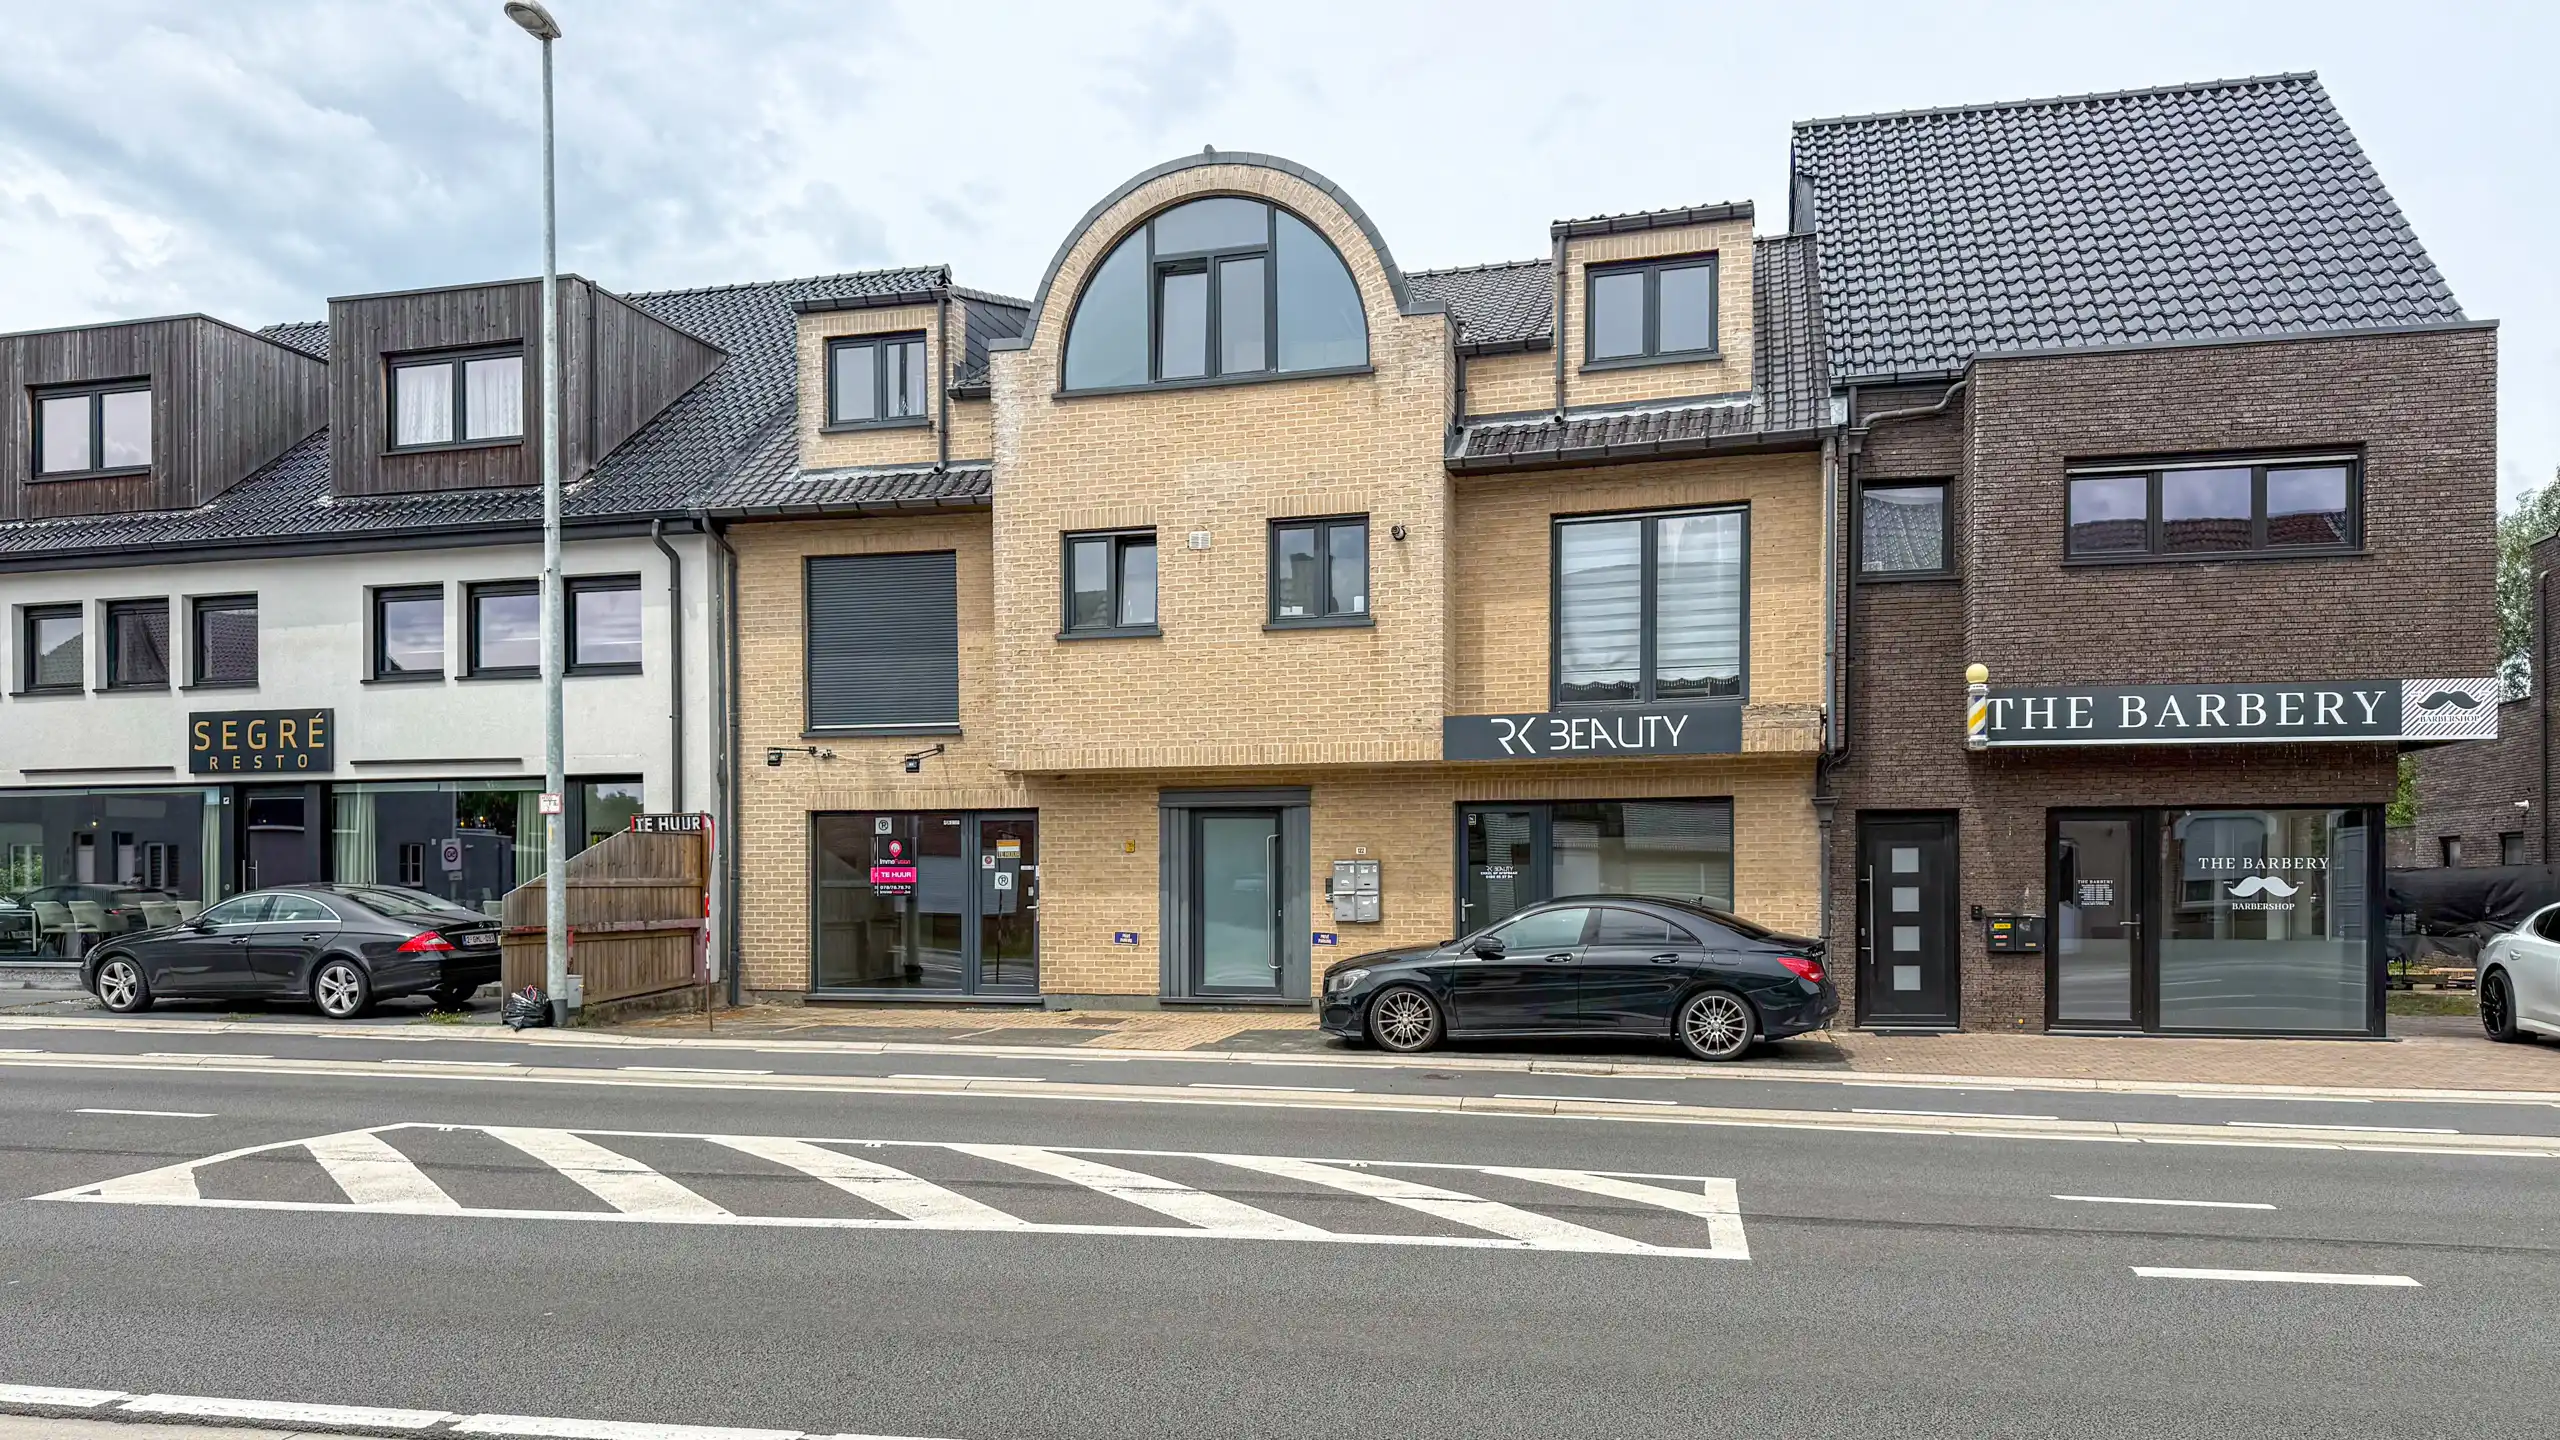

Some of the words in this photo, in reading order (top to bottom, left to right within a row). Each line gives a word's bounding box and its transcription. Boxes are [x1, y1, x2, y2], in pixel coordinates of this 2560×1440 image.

[1985, 696, 2094, 730] THE
[2118, 690, 2387, 728] BARBERY
[2420, 715, 2480, 723] BARBERSHOP
[193, 711, 325, 751] SEGRÉ
[1490, 717, 1537, 755] RK
[1550, 714, 1689, 750] BEAUTY
[209, 754, 308, 770] RESTO
[635, 817, 653, 832] TE
[658, 816, 701, 832] HUUR
[2198, 857, 2236, 869] THE
[2243, 857, 2330, 870] BARBERY
[2232, 902, 2296, 911] BARBERSHOP
